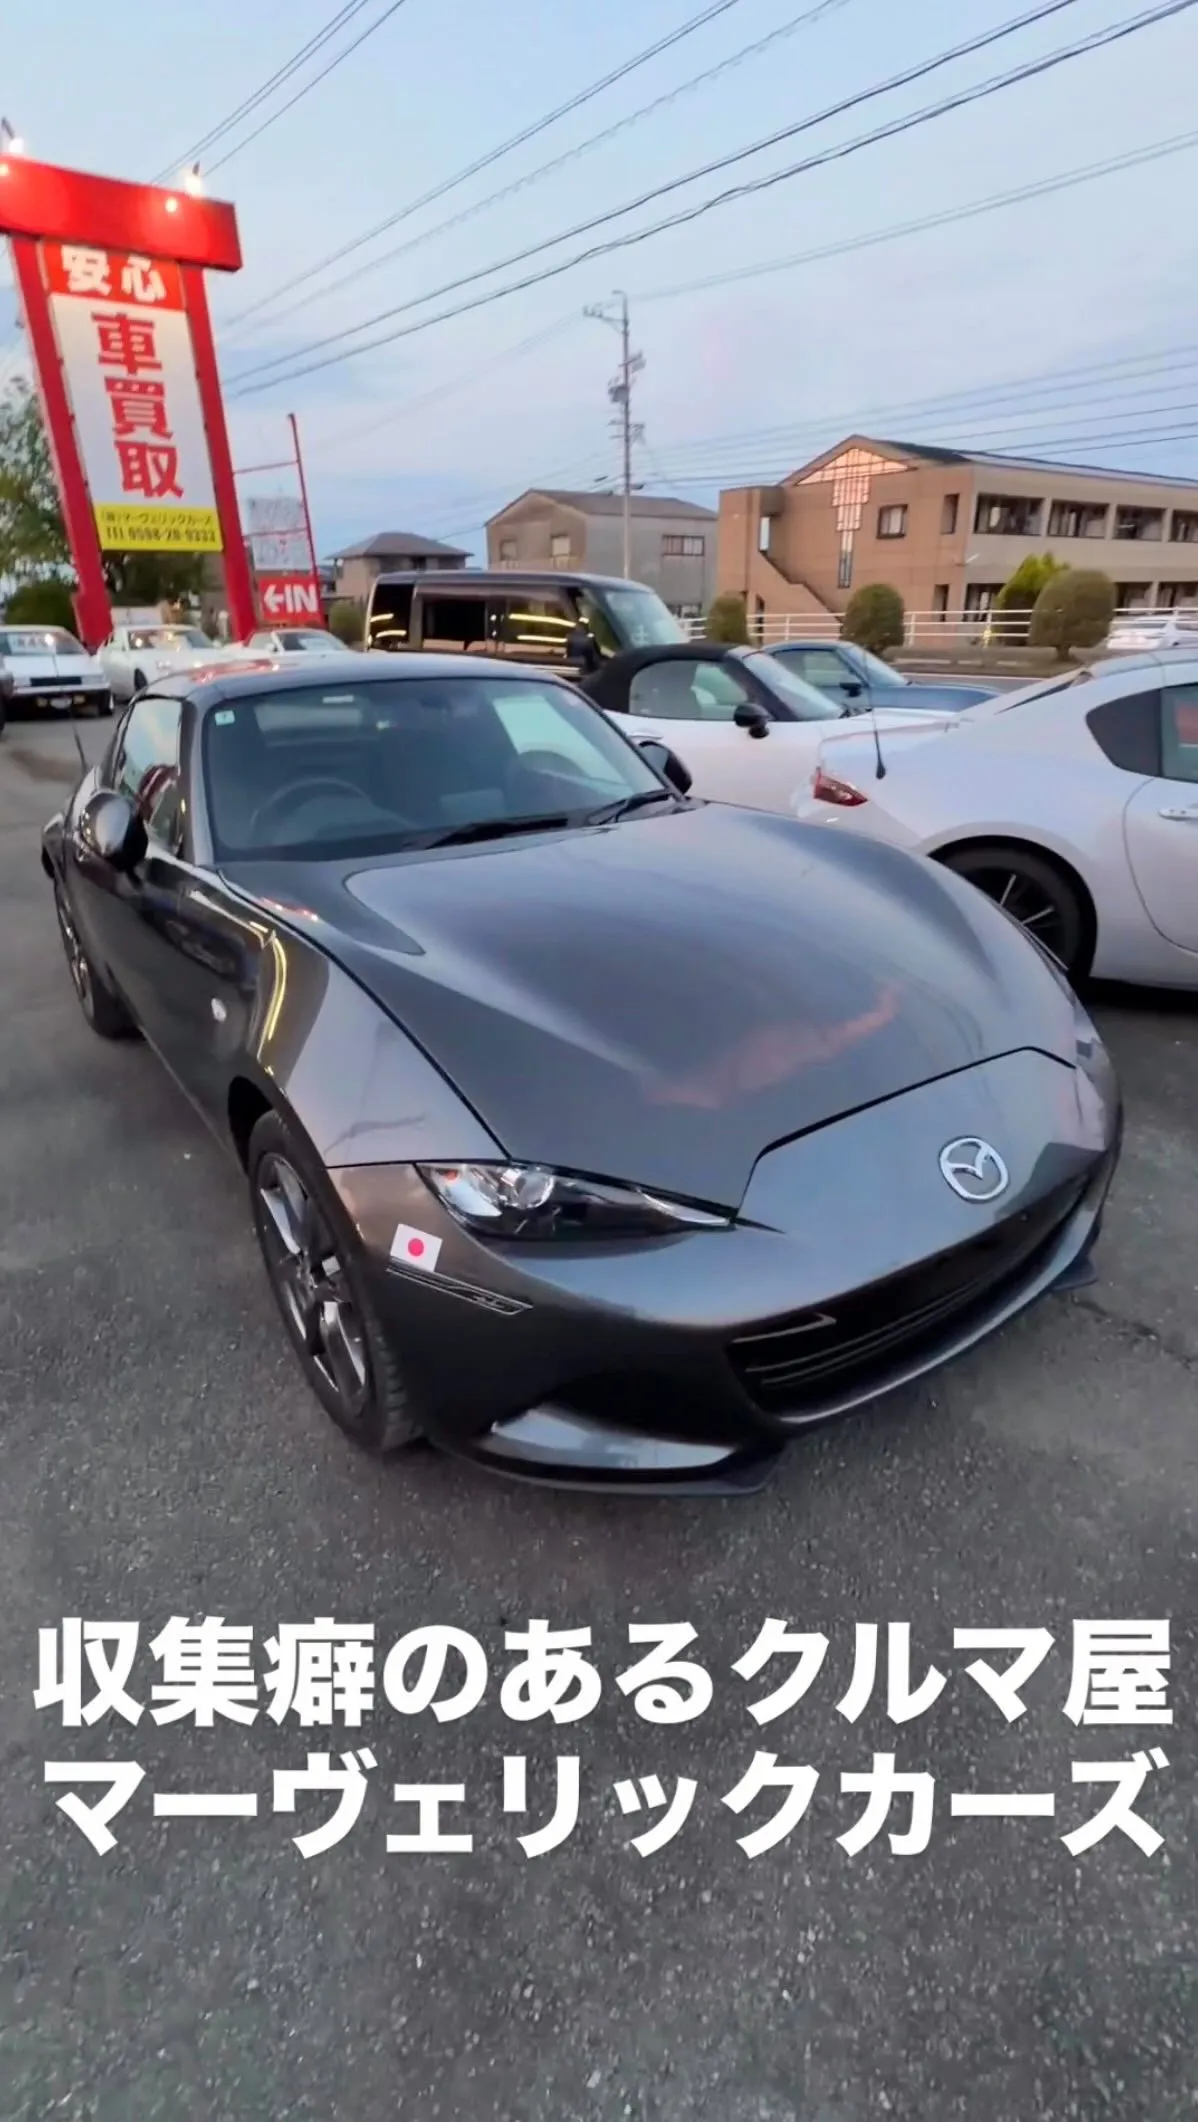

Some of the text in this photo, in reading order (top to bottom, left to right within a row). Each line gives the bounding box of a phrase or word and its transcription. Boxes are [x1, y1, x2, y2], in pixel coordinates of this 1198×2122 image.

[61, 244, 167, 303] 安心
[91, 311, 184, 498] 車買取
[284, 583, 319, 614] IN
